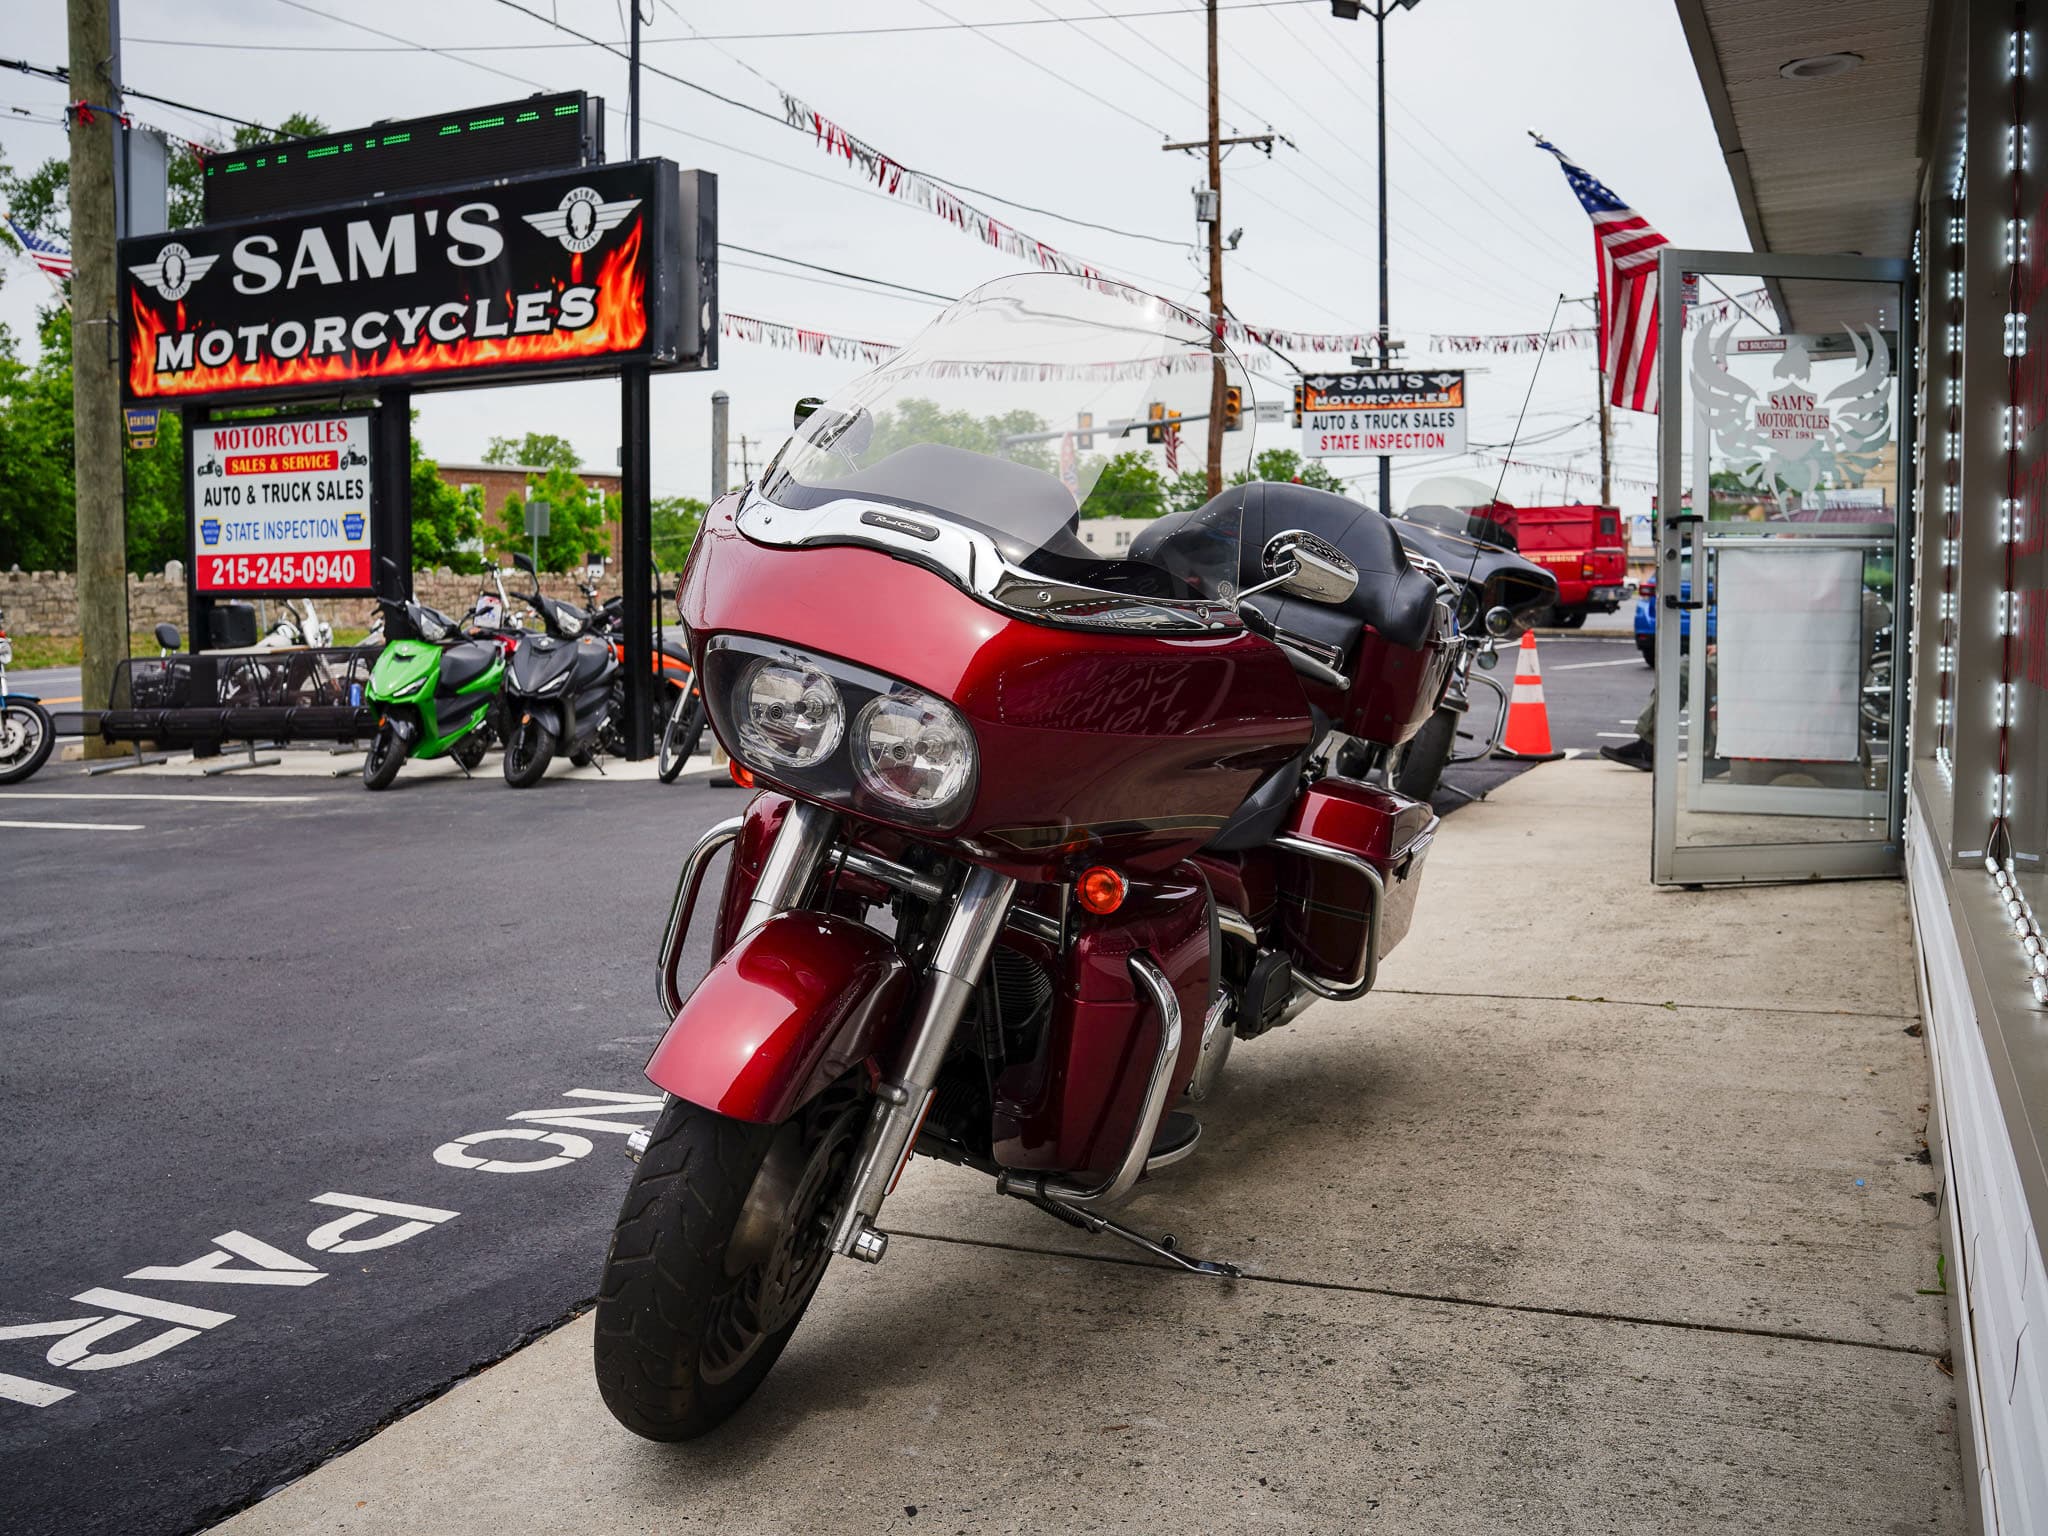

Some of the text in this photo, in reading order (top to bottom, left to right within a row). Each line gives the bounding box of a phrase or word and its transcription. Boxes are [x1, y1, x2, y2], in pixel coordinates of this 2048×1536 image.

[566, 188, 596, 203] MOTOR
[232, 202, 504, 295] SAM'S
[156, 287, 597, 371] MOTORCYCLES
[1340, 374, 1425, 391] SAM'S
[1315, 393, 1449, 406] MOTORCYCLES
[1771, 394, 1815, 411] SAM'S
[1312, 412, 1455, 430] AUTO & TRUCK SALES
[1757, 412, 1830, 430] MOTORCYCLES
[213, 420, 348, 450] MOTORCYCLES
[1320, 433, 1445, 450] STATE INSPECTION
[1772, 429, 1790, 439] EST
[231, 454, 331, 473] SALES & SERVICE
[204, 479, 364, 507] AUTO & TRUCK SALES
[225, 522, 260, 542] STATE
[264, 519, 339, 541] INSPECTION
[212, 555, 355, 585] 215-245-0940
[0, 1088, 664, 1407] NO PAR
